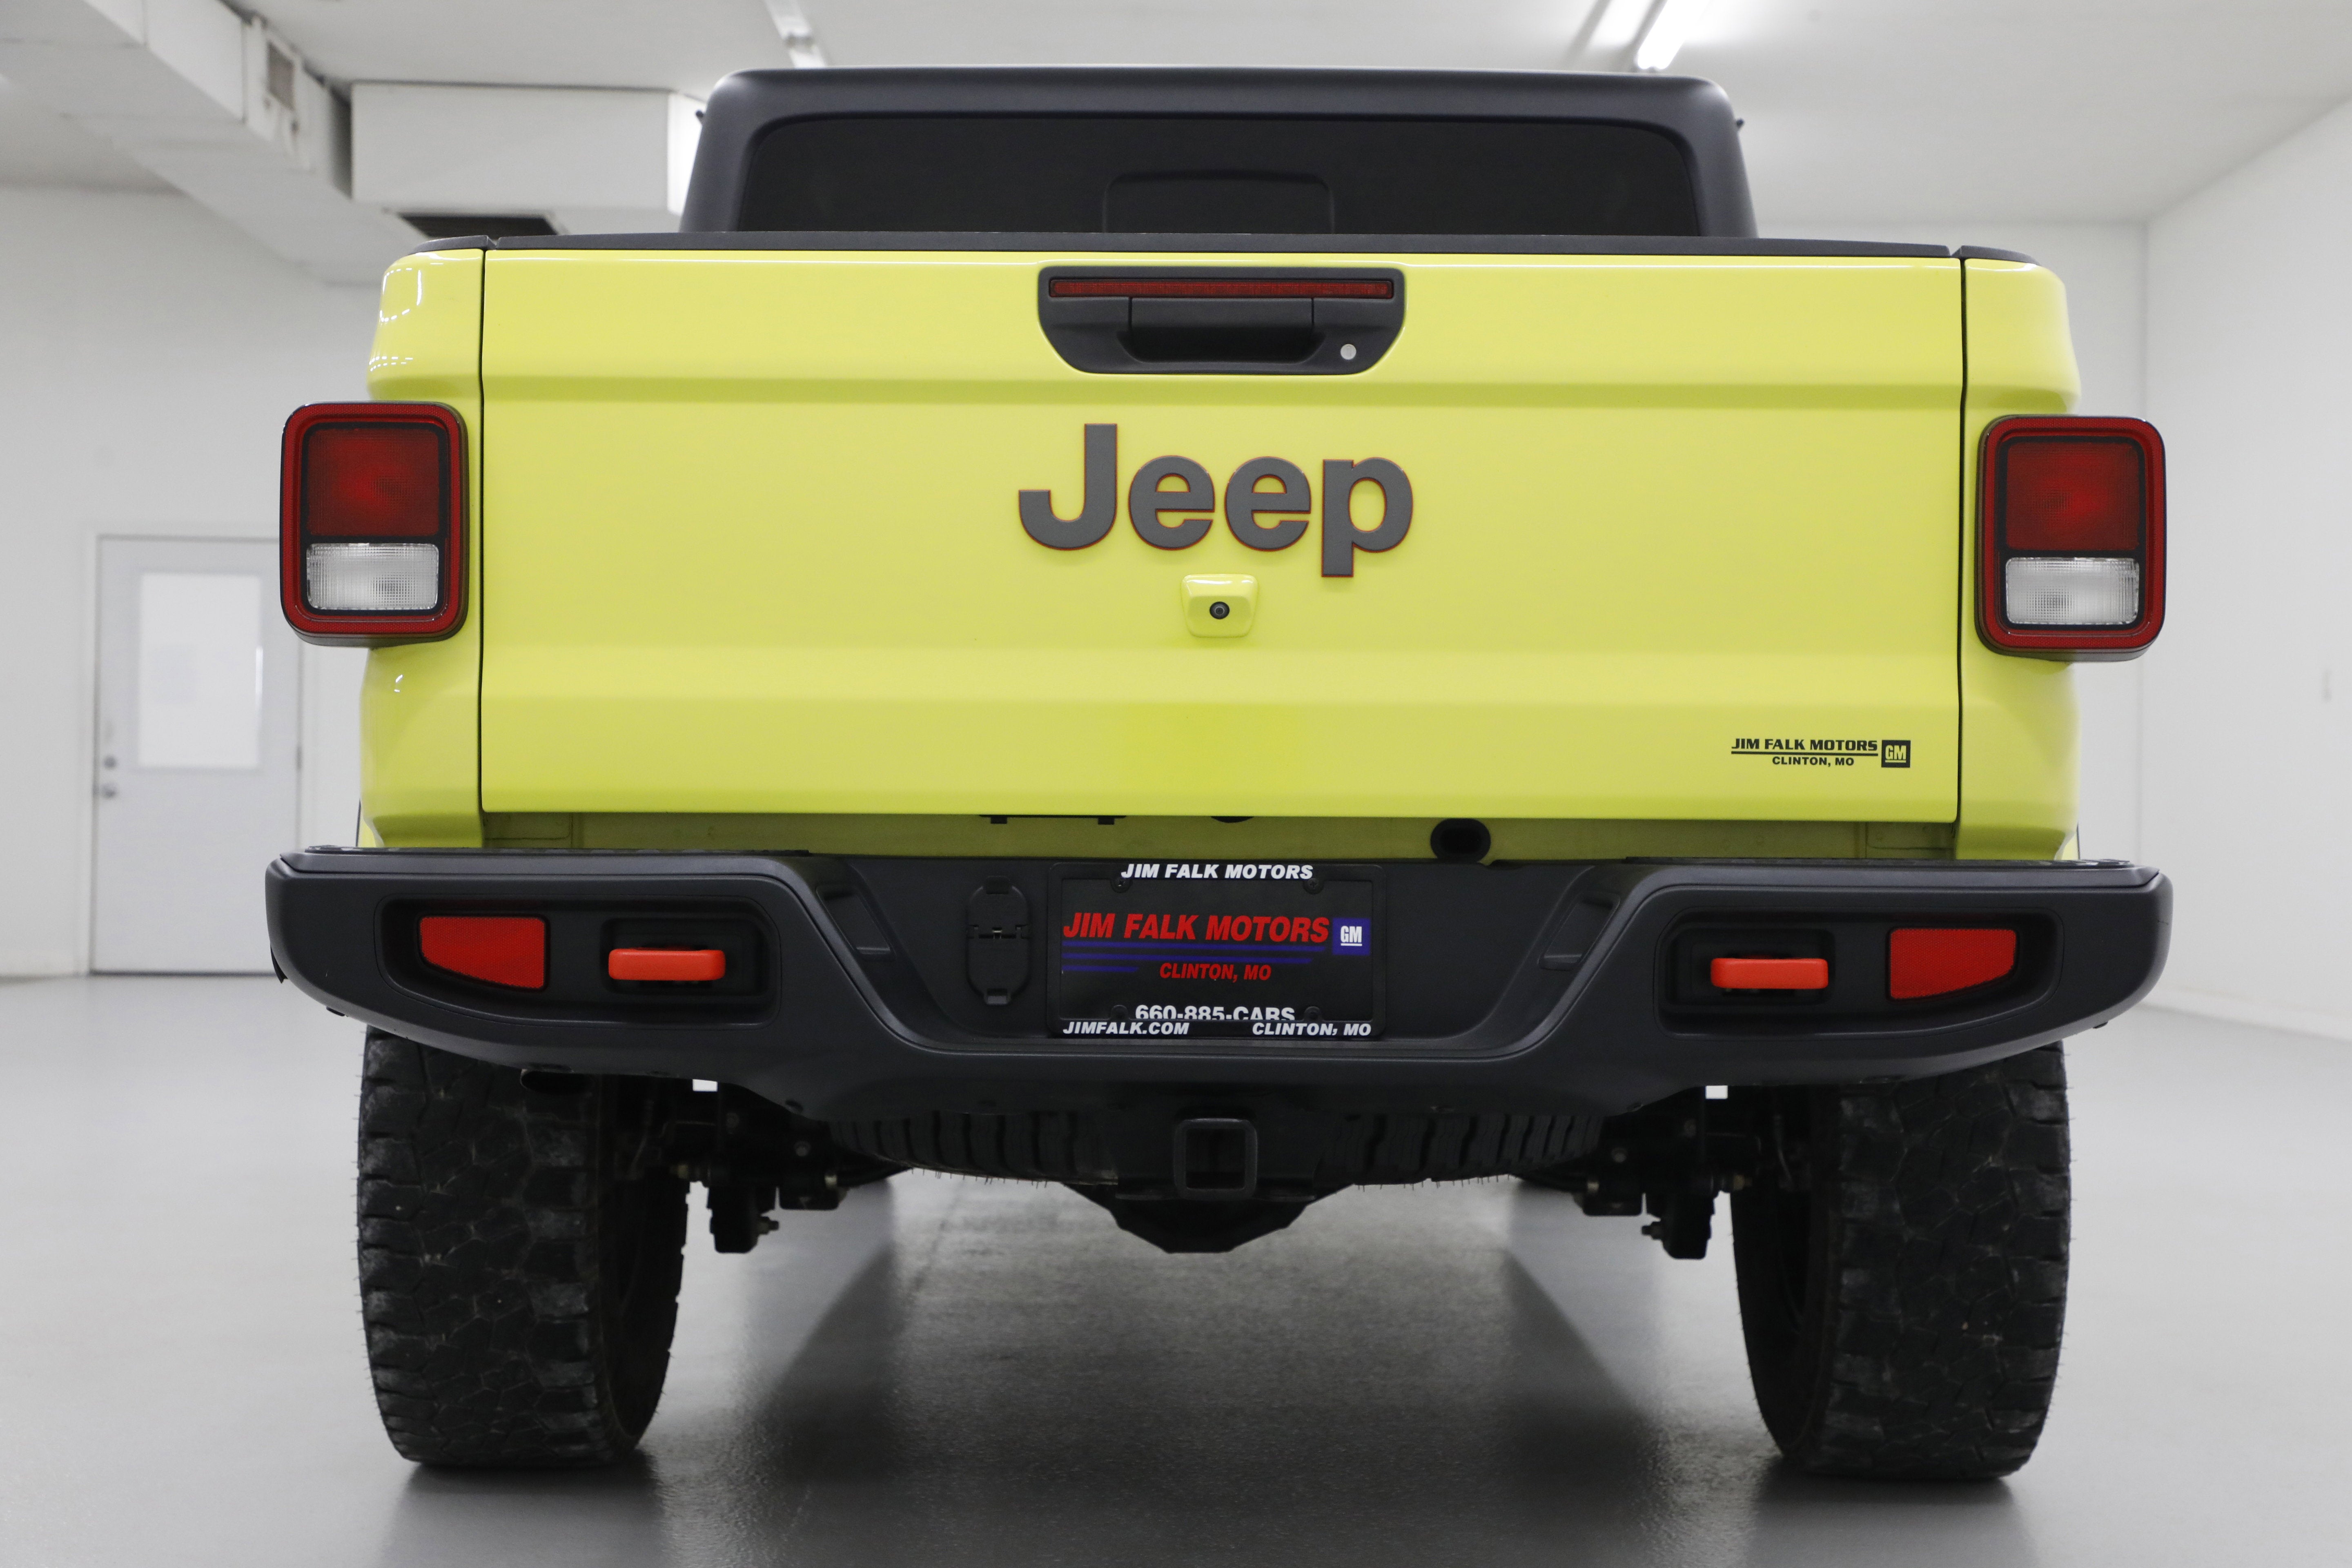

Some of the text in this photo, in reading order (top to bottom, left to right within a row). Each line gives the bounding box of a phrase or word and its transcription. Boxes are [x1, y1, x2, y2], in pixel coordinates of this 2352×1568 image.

[1018, 423, 1413, 577] Jeep
[1731, 738, 1878, 751] JIM FALK MOTORS
[1885, 745, 1907, 760] GM
[1772, 756, 1854, 767] CLINTON, MO
[1120, 864, 1314, 880] JIM FALK MOTORS
[1062, 912, 1330, 943] JIM FALK MOTORS
[1340, 926, 1363, 943] GM
[1159, 962, 1272, 983] CLINTON, MO
[1135, 1004, 1295, 1020] 660-885-CARS
[1062, 1021, 1190, 1035] JIMFALK.COM
[1252, 1022, 1372, 1036] CLINTON, MO
